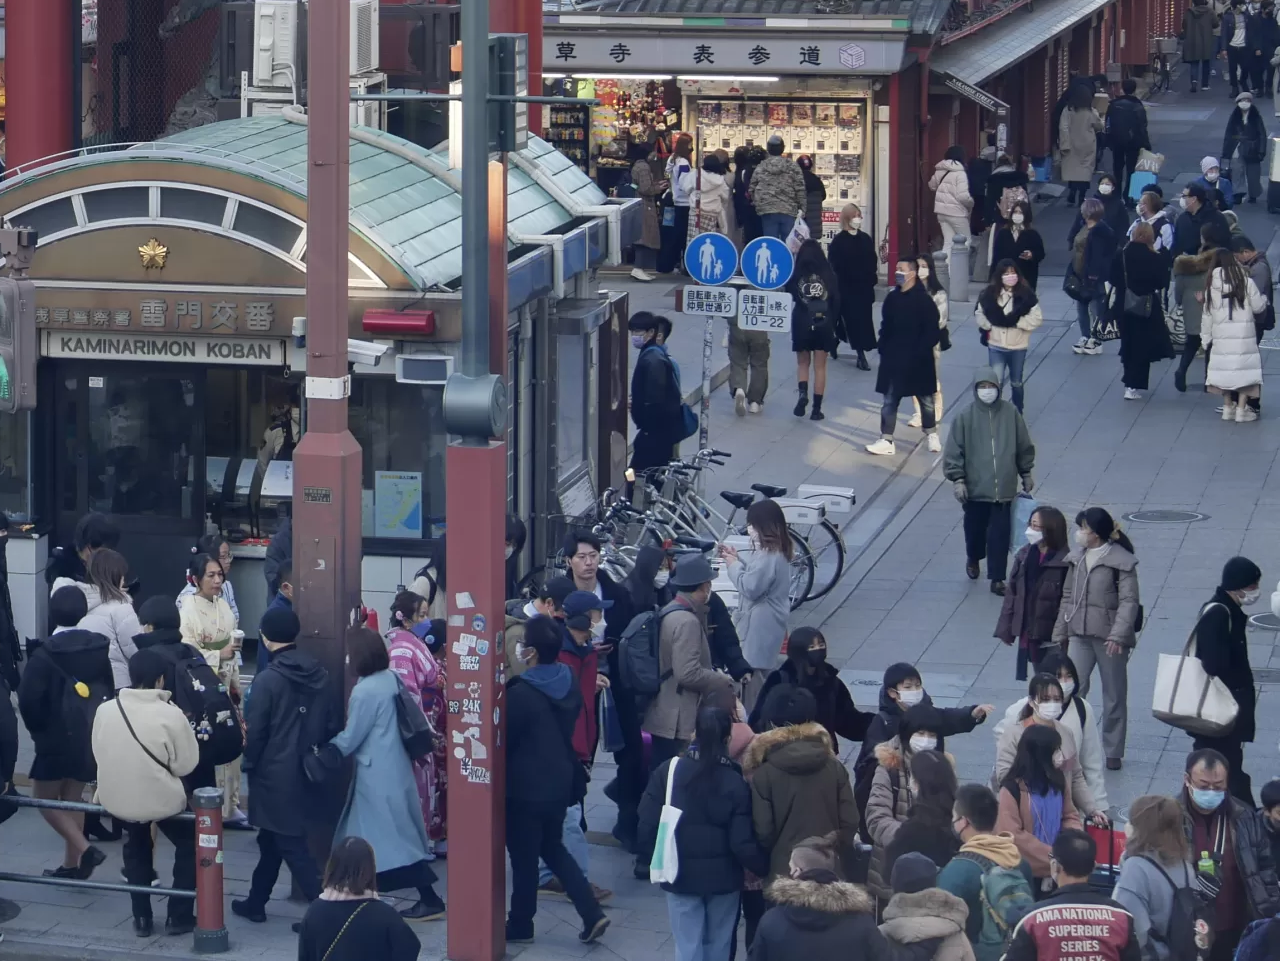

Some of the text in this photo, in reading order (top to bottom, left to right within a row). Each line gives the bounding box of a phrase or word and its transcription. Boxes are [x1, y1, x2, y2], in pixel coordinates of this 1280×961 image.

[692, 44, 822, 67] 表参道
[687, 290, 732, 302] 自転車を除く
[742, 294, 766, 305] 自転車
[686, 302, 732, 313] 仲見世通り
[741, 304, 765, 315] 人力車
[769, 301, 788, 312] を除く
[139, 298, 276, 332] 雷門交番
[60, 337, 271, 360] KAMINARIMON KOBAN
[462, 698, 481, 713] 24K
[1035, 908, 1116, 924] AMA NATIONAL
[1048, 925, 1110, 938] SUPERBIKE
[1060, 940, 1100, 952] SERIES
